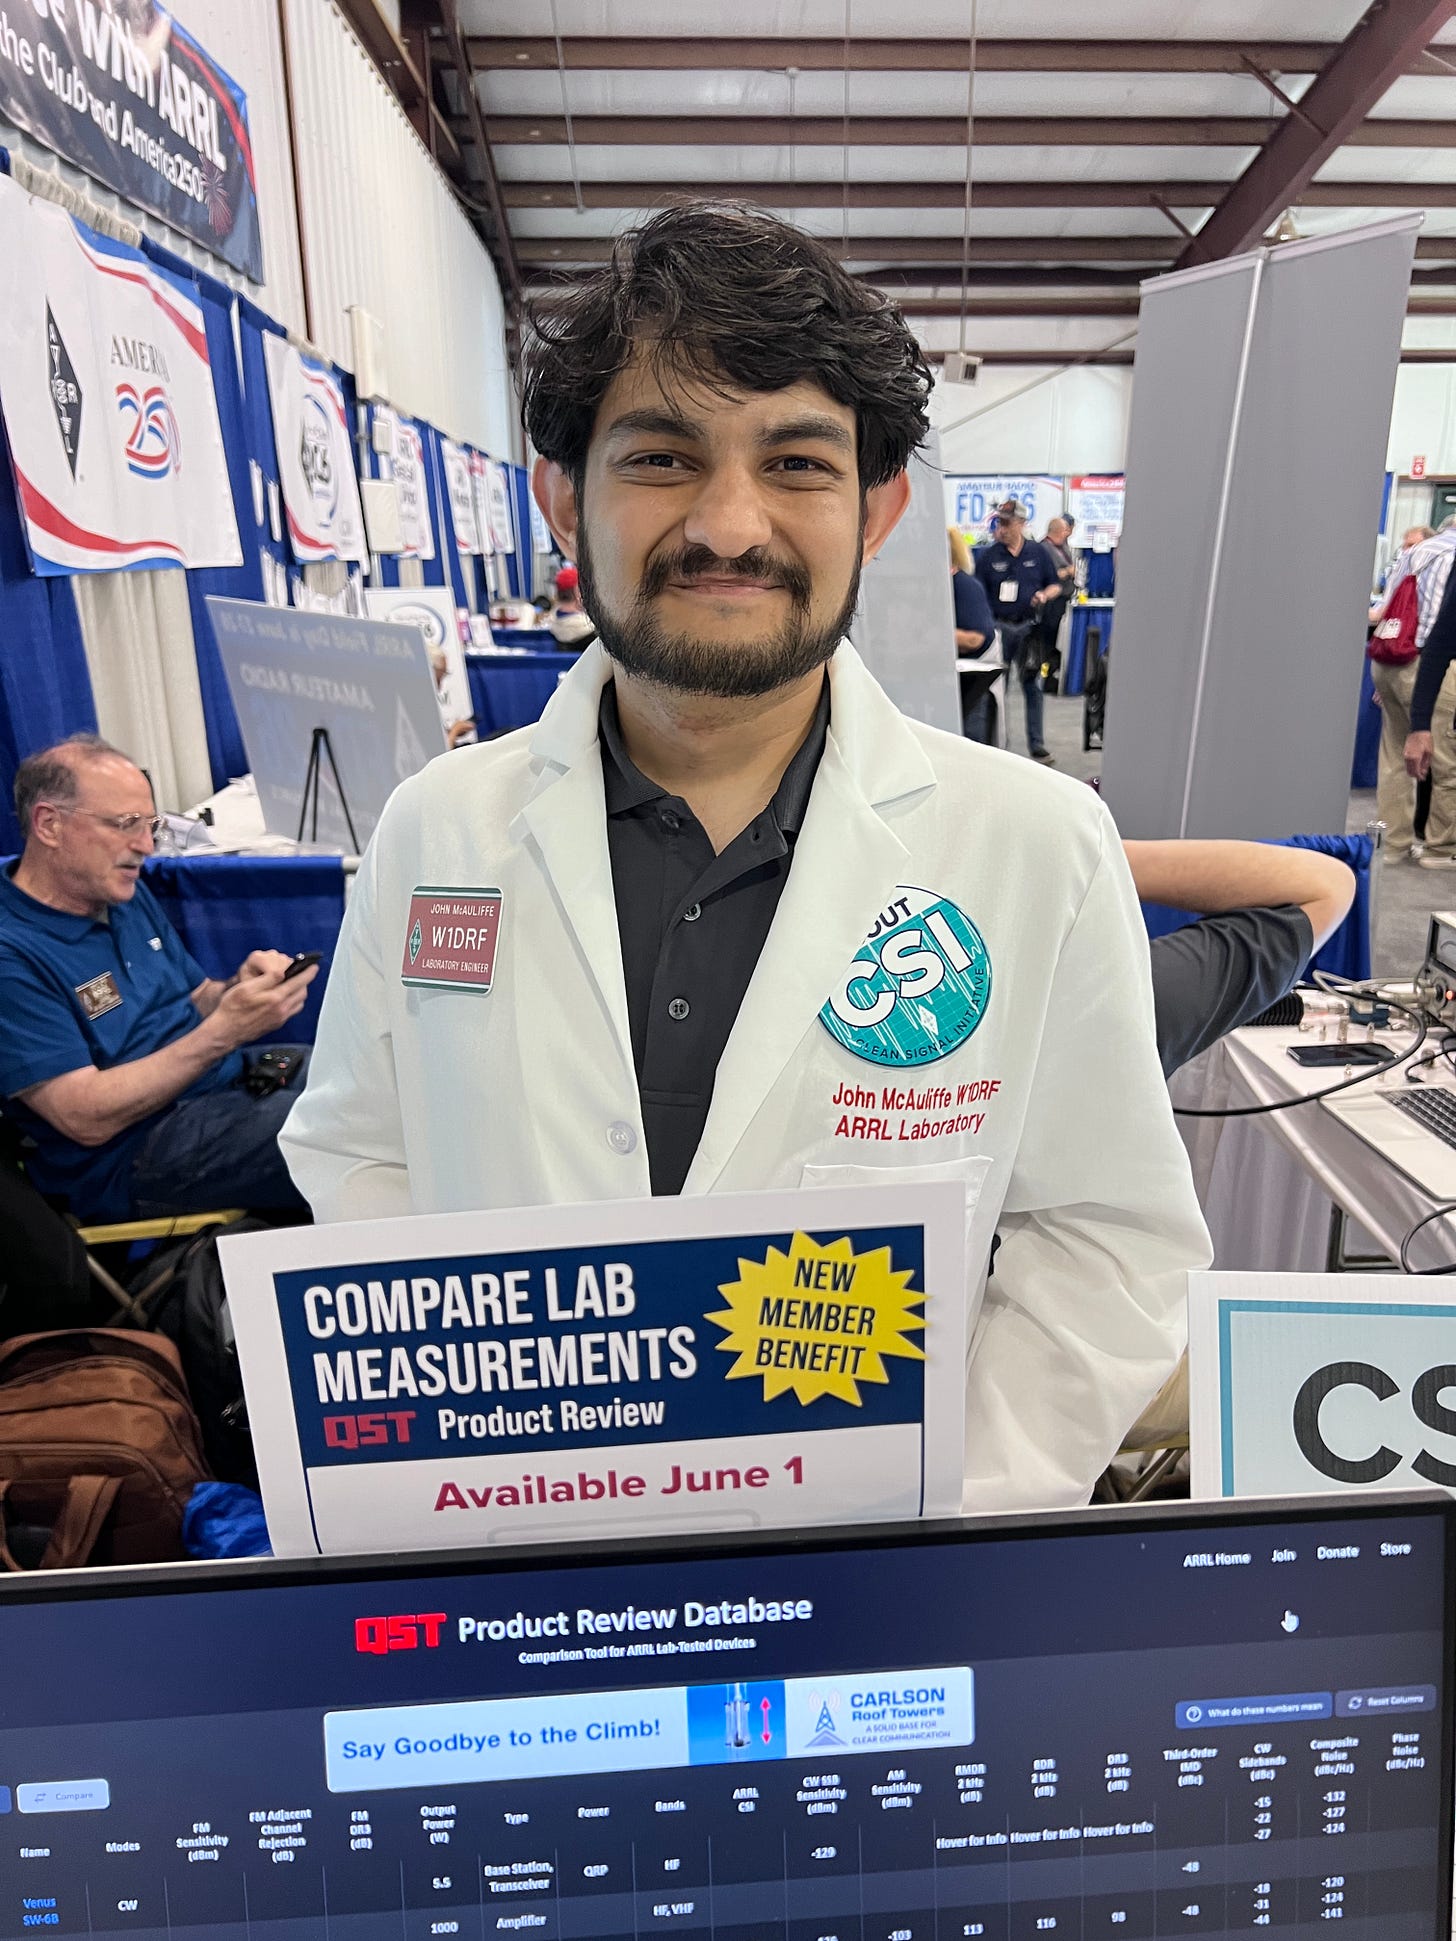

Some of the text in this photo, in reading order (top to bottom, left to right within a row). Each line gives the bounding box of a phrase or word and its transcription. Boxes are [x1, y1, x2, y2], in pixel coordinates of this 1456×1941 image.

[159, 49, 227, 172] ARRL
[37, 42, 88, 113] Club
[121, 109, 204, 203] America250
[431, 903, 495, 917] JOHN McAULIFFE
[432, 926, 488, 951] W1DRF
[422, 958, 489, 973] LABORATORY ENGINEER
[829, 909, 973, 1028] CSI
[905, 1035, 954, 1059] SIGNAL
[953, 968, 984, 1036] INITIATIVE
[832, 1080, 1001, 1111] John McAuliffe W1DRF
[835, 1113, 985, 1141] ARRL Laboratory
[793, 1256, 857, 1293] NEW
[303, 1261, 636, 1340] COMPARE LAB
[757, 1297, 877, 1337] MEMBER
[754, 1337, 867, 1376] BENEFIT
[312, 1325, 698, 1404] MEASUREMENTS
[322, 1400, 665, 1449] QST Product Review
[433, 1456, 805, 1512] Available June 1
[1271, 1549, 1297, 1563] Join
[1317, 1545, 1361, 1560] Donate
[1380, 1542, 1412, 1556] Store
[1183, 1552, 1251, 1568] ARRL Home
[354, 1597, 813, 1654] QST Product Review Database
[518, 1637, 757, 1666] Comparison Tool for ARRL Lab-Tested Devices
[850, 1687, 945, 1708] CARLSON
[1390, 1694, 1424, 1706] Columns
[852, 1706, 945, 1722] Roof Towers
[1208, 1702, 1323, 1718] What do these numbers mean
[899, 1722, 918, 1730] BASE
[343, 1719, 661, 1760] Say Goodbye to the Climb!
[852, 1731, 951, 1745] CLEAR COMMUNICATION
[1310, 1736, 1359, 1751] Composite
[1163, 1747, 1218, 1761] Third-Order
[1253, 1743, 1272, 1754] CW
[1239, 1755, 1287, 1769] Sidebands
[802, 1776, 820, 1788] CW
[887, 1769, 906, 1781] AM
[733, 1787, 759, 1800] ARRL
[796, 1787, 847, 1802] Sensitivity
[871, 1782, 922, 1796] Sensitivity
[55, 1791, 93, 1803] Compare
[420, 1804, 457, 1817] Output
[577, 1807, 610, 1818] Power
[655, 1800, 687, 1812] Bands
[249, 1808, 312, 1823] FM Adjacent
[351, 1810, 369, 1822] FM
[504, 1812, 529, 1825] Type
[192, 1822, 210, 1834] FM
[260, 1823, 303, 1836] Channel
[422, 1819, 456, 1831] Power
[1083, 1821, 1154, 1838] Hover for Info
[429, 1832, 450, 1845] (W)
[936, 1832, 1008, 1849] Hover for Info
[1010, 1826, 1082, 1844] Hover for Info
[1253, 1828, 1272, 1840] -27
[105, 1841, 141, 1853] Modes
[176, 1834, 229, 1849] Sensitivity
[258, 1836, 307, 1850] Rejection
[20, 1847, 50, 1858] Name
[188, 1849, 219, 1863] (dBm)
[272, 1850, 295, 1863] (dB)
[484, 1861, 554, 1877] Base Station,
[583, 1864, 609, 1878] QRP
[432, 1876, 452, 1889] 5.5
[488, 1878, 550, 1893] Transceiver
[23, 1897, 57, 1910] Venus
[118, 1899, 138, 1911] CW
[430, 1921, 459, 1934] 1000
[496, 1914, 547, 1930] Amplifier
